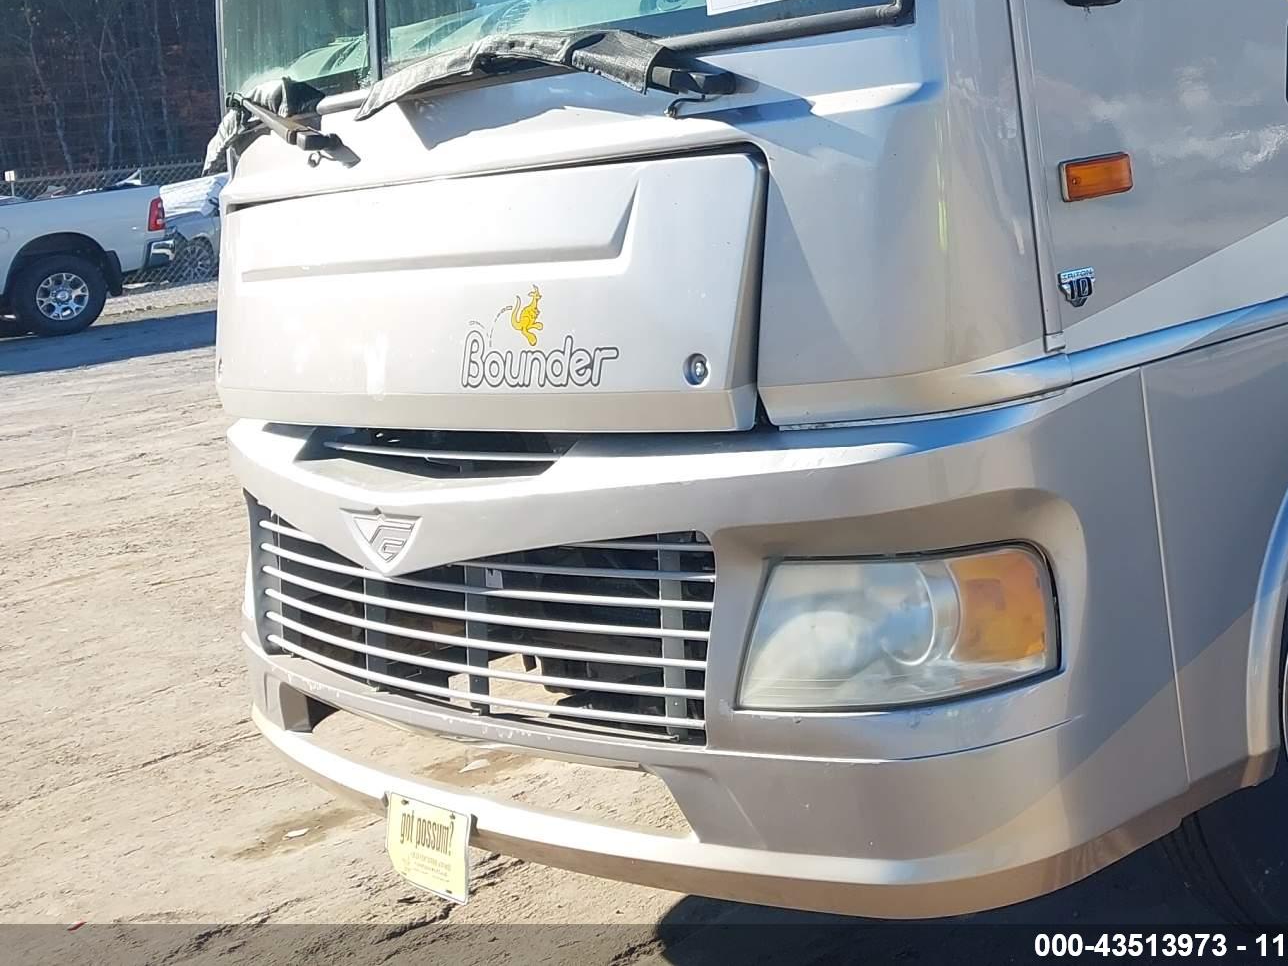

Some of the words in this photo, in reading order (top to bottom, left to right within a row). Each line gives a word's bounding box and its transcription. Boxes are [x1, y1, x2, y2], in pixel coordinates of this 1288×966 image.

[1061, 268, 1093, 281] TRITON
[461, 330, 619, 388] Bounder
[399, 810, 415, 844] got
[415, 819, 455, 856] possum?
